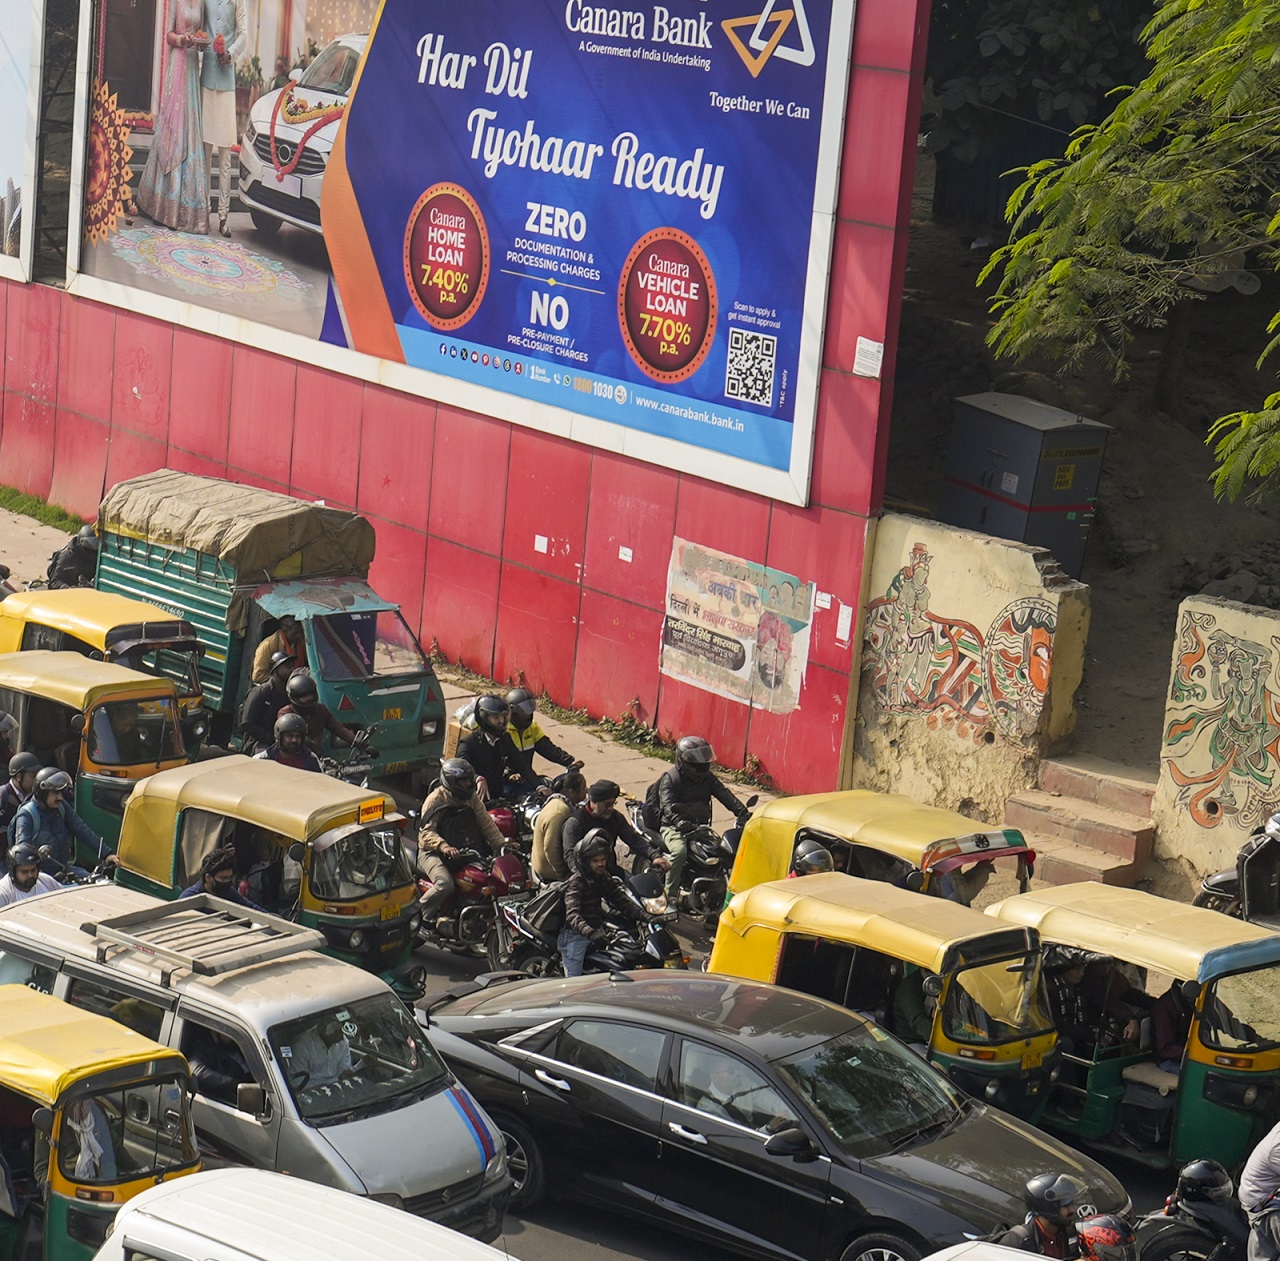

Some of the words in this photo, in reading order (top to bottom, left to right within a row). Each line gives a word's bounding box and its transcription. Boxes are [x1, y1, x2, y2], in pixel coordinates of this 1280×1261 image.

[565, 0, 645, 40] Canara
[651, 6, 713, 49] Bank
[416, 33, 476, 90] Har
[484, 42, 533, 99] Dil
[578, 41, 585, 51] A
[586, 42, 632, 59] Government
[632, 47, 641, 59] of
[641, 48, 661, 62] India
[662, 51, 711, 71] Undertaking
[709, 92, 763, 113] Together
[765, 99, 784, 116] We
[786, 102, 810, 119] Can
[467, 107, 604, 179] Tyohaar
[611, 131, 725, 220] Ready
[430, 207, 466, 230] Canara
[525, 201, 587, 242] ZERO
[428, 226, 466, 248] HOME
[428, 245, 463, 267] LOAN
[514, 238, 586, 261] DOCUMENTATION
[587, 253, 594, 264] &
[506, 251, 558, 272] PROCESSING
[560, 262, 601, 281] CHARGES
[648, 253, 689, 278] Canara
[439, 291, 457, 304] p.a.
[637, 271, 699, 300] VEHICLE
[530, 290, 569, 330] NO
[646, 292, 687, 317] LOAN
[733, 301, 747, 312] Scan
[756, 306, 771, 318] apply
[727, 312, 737, 321] get
[737, 312, 756, 325] instant
[756, 316, 781, 329] approval
[507, 335, 554, 355] PRE-CLOSURE
[555, 346, 589, 363] CHARGES
[522, 327, 568, 345] PRE-PAYMENT
[660, 341, 679, 355] p.a.
[593, 382, 613, 399] 1030
[635, 397, 745, 432] www.canarabank.bank.in
